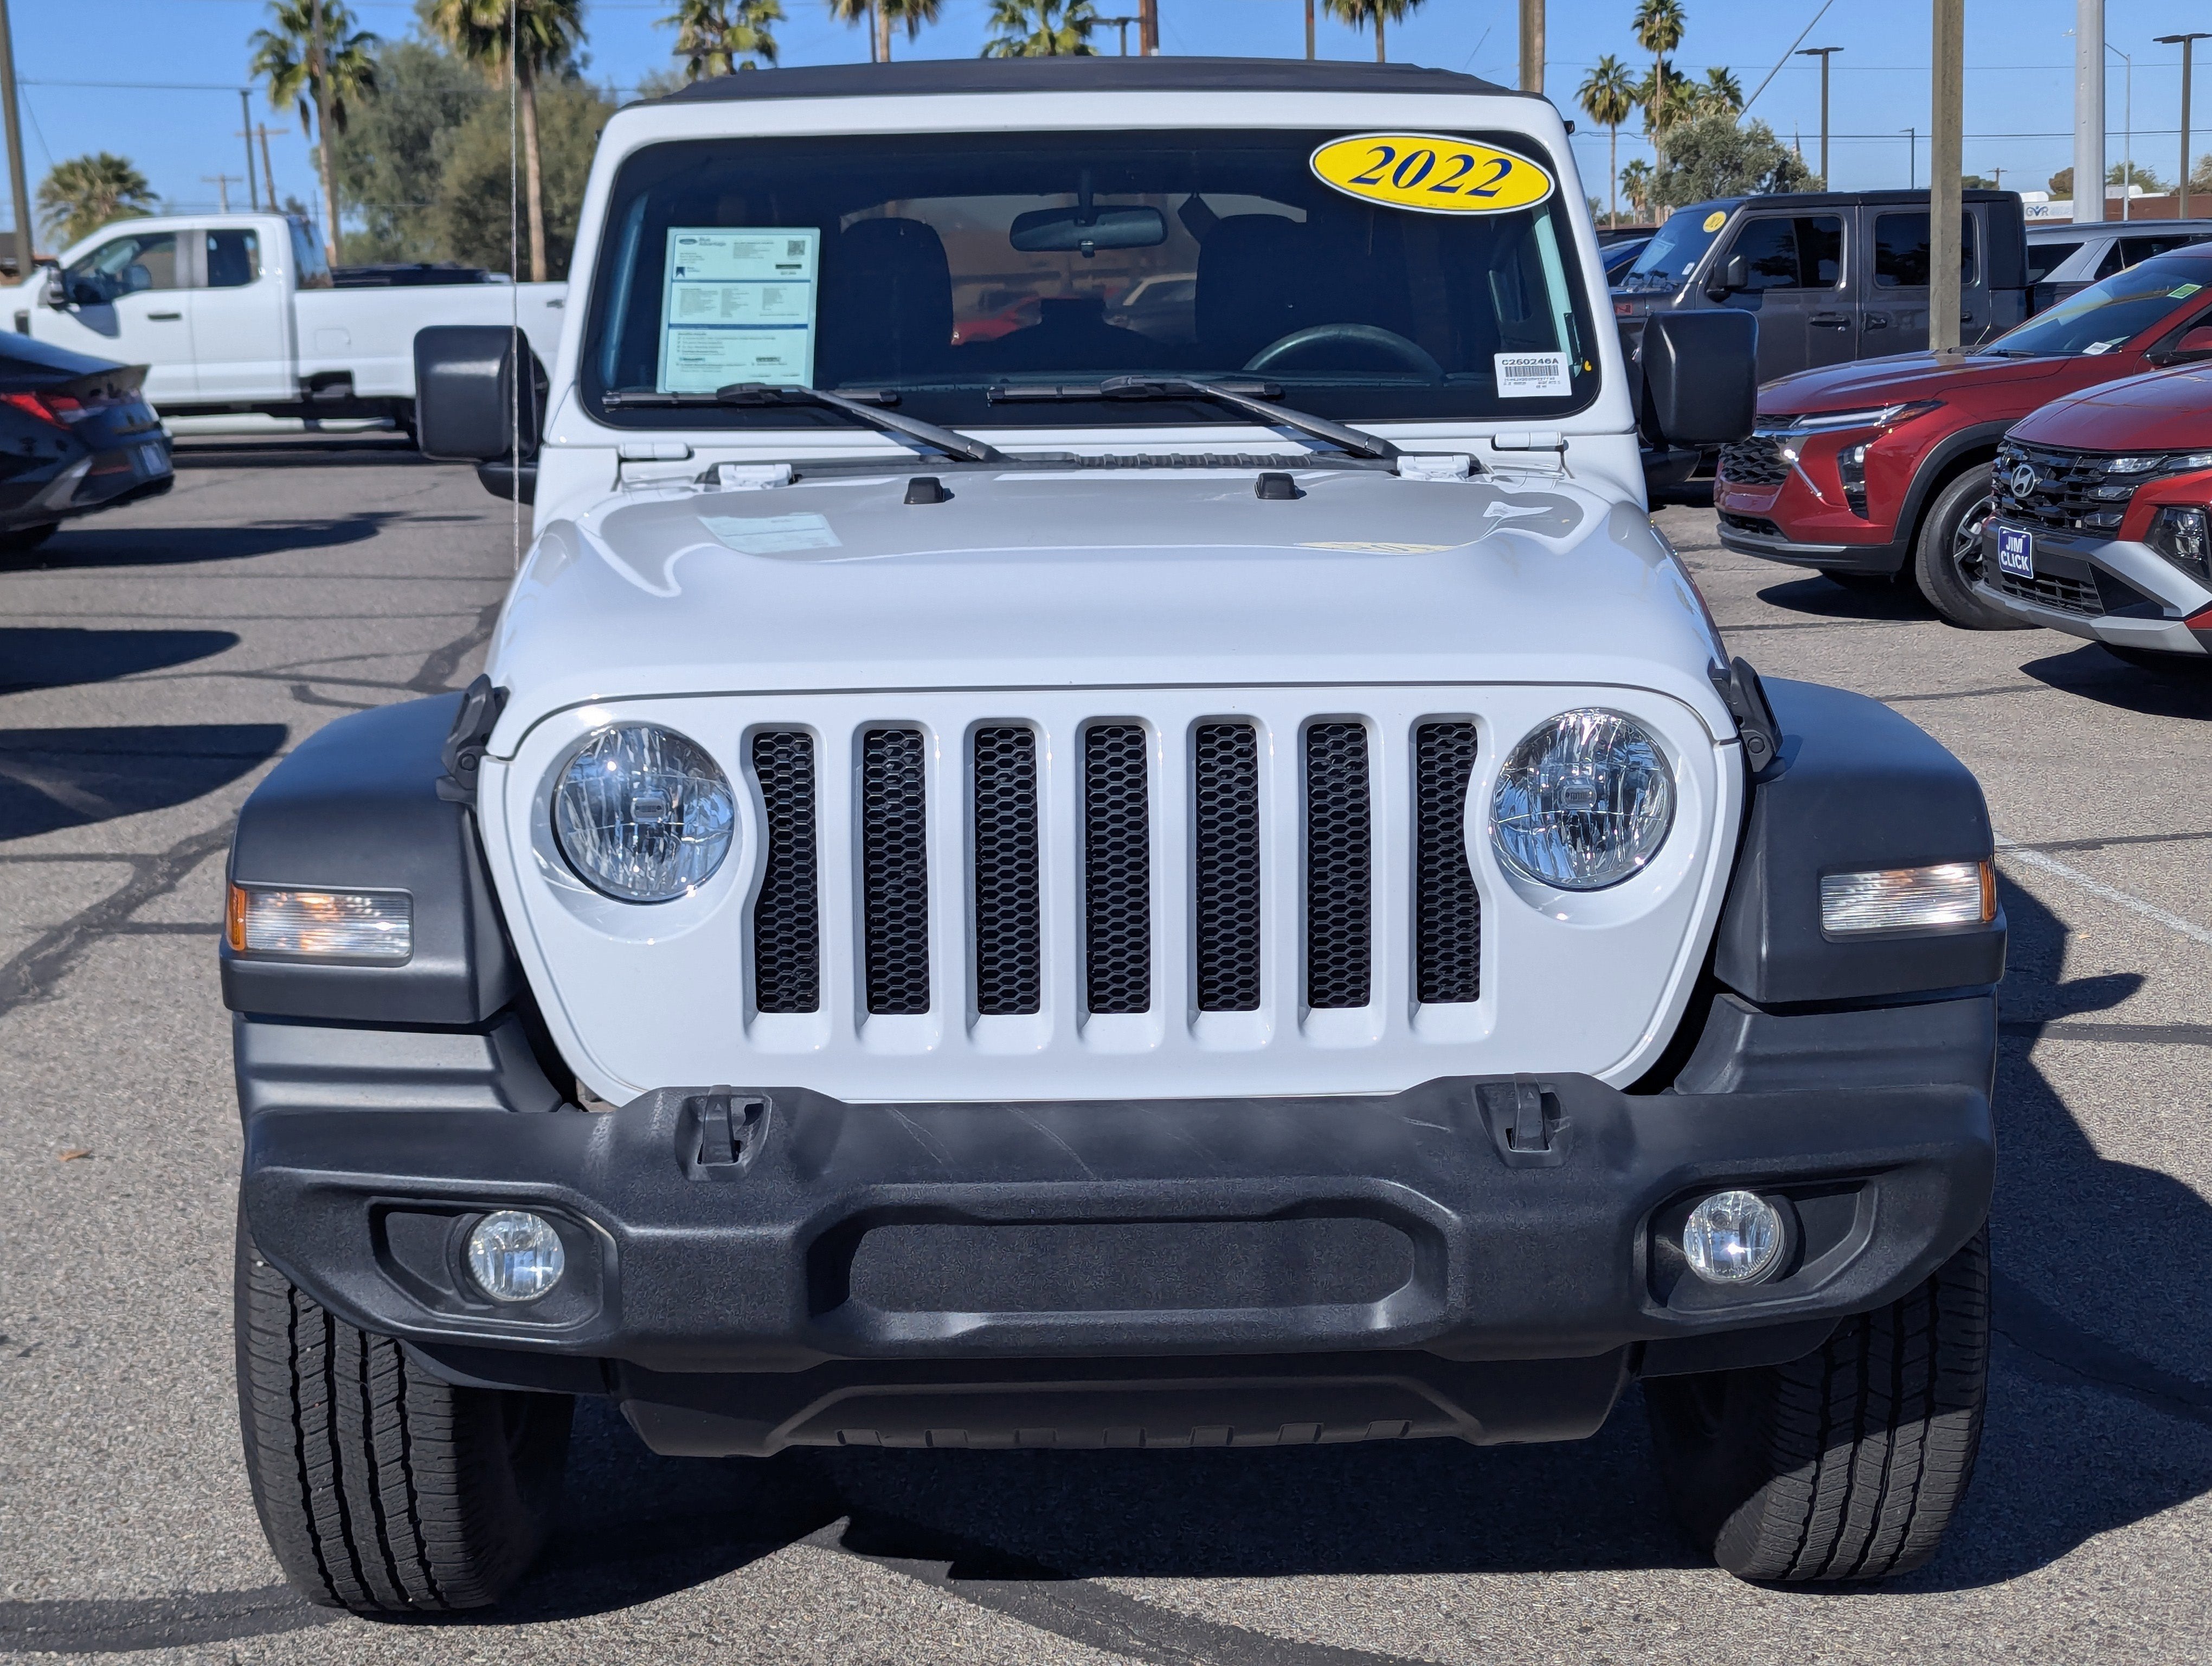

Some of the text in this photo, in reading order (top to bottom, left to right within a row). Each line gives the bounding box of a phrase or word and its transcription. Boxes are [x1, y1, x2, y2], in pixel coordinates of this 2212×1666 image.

[1347, 146, 1513, 197] 2022
[2026, 206, 2049, 216] GVR
[2006, 536, 2023, 553] JIM
[2001, 550, 2030, 571] CLICK
